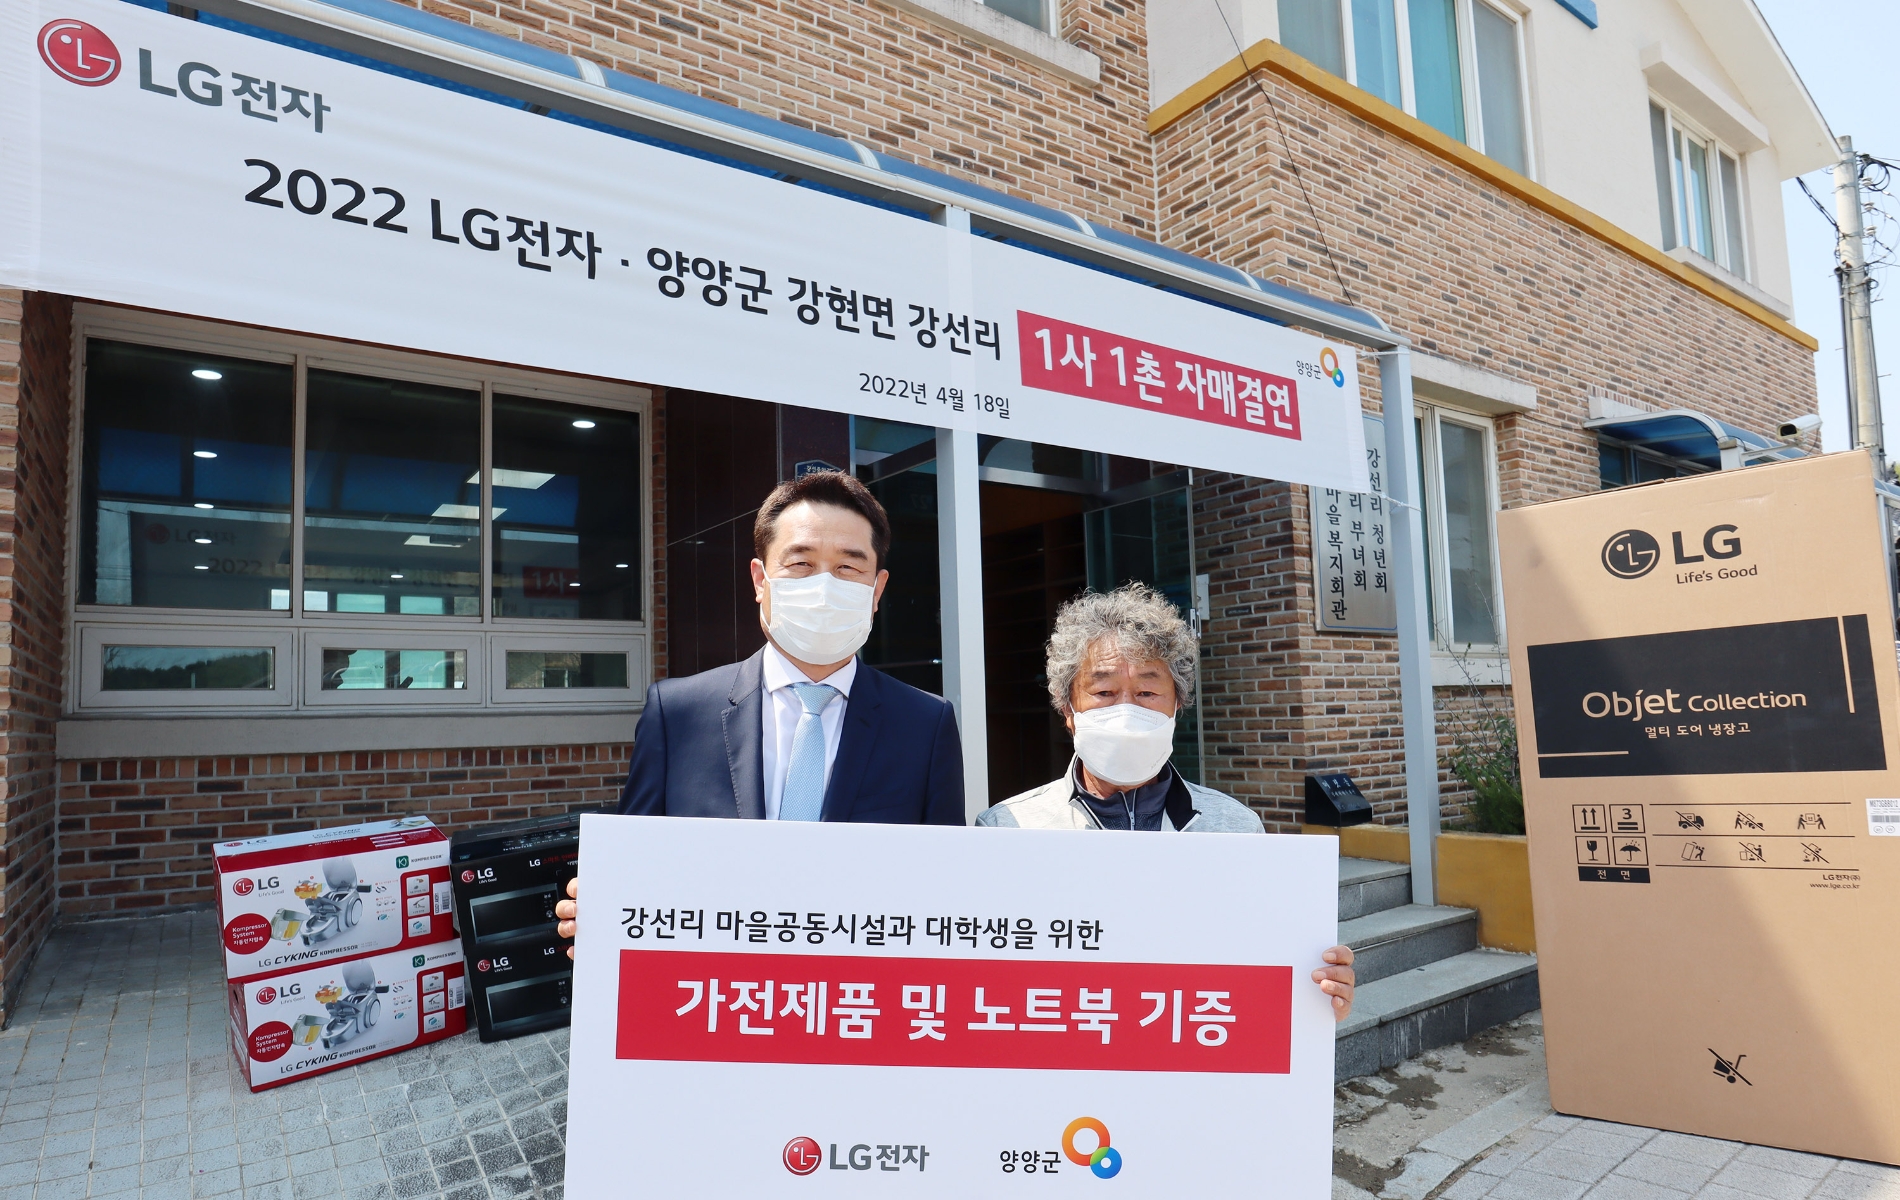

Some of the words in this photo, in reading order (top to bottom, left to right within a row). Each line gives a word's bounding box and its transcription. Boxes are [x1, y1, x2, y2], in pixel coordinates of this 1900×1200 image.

[138, 47, 332, 134] LG전자
[243, 158, 409, 234] 2022
[430, 198, 603, 281] LG전자
[646, 247, 773, 316] 양양군
[787, 276, 896, 342] 강현면
[908, 303, 1001, 361] 강선리
[1034, 328, 1097, 388] 1사
[1109, 346, 1166, 405] 1촌
[1175, 360, 1293, 431] 자매결연
[1296, 359, 1322, 381] 양양군
[859, 372, 927, 406] 2022년
[936, 386, 965, 412] 4월
[973, 393, 1010, 420] 18일
[1367, 448, 1383, 516] 강선리
[1671, 523, 1742, 565] LG
[1350, 521, 1368, 592] 부녀회
[1372, 524, 1388, 593] 청년회
[1676, 570, 1714, 585] Life's
[1718, 564, 1758, 580] Good
[1582, 688, 1682, 722] Objet
[1688, 690, 1807, 713] Collection
[1644, 725, 1670, 739] 멀티
[1676, 724, 1703, 737] 도어
[1708, 722, 1751, 736] 냉장고
[1622, 807, 1633, 820] 3
[477, 868, 494, 879] LG
[529, 859, 541, 867] LG
[257, 876, 280, 891] LG
[232, 923, 267, 933] Kompressor
[232, 931, 255, 939] System
[621, 907, 704, 940] 강선리
[716, 910, 917, 946] 마을공동시설과
[925, 916, 1038, 950] 대학생을
[1047, 919, 1104, 951] 위한
[258, 958, 272, 968] LG
[274, 949, 320, 965] CYKING
[319, 944, 359, 956] KOMPRESSOR
[493, 957, 509, 968] LG
[543, 947, 555, 956] LG
[280, 983, 302, 998] LG
[675, 978, 881, 1039] 가전제품
[901, 984, 947, 1041] 및
[967, 986, 1119, 1045] 노트북
[1138, 989, 1237, 1047] 기증
[255, 1030, 289, 1041] Kompressor
[256, 1038, 277, 1047] System
[280, 1065, 293, 1075] LG
[295, 1053, 339, 1070] CYKING
[339, 1044, 377, 1058] KOMPRESSOR
[829, 1143, 930, 1172] LG전자
[999, 1149, 1062, 1174] 양양군
